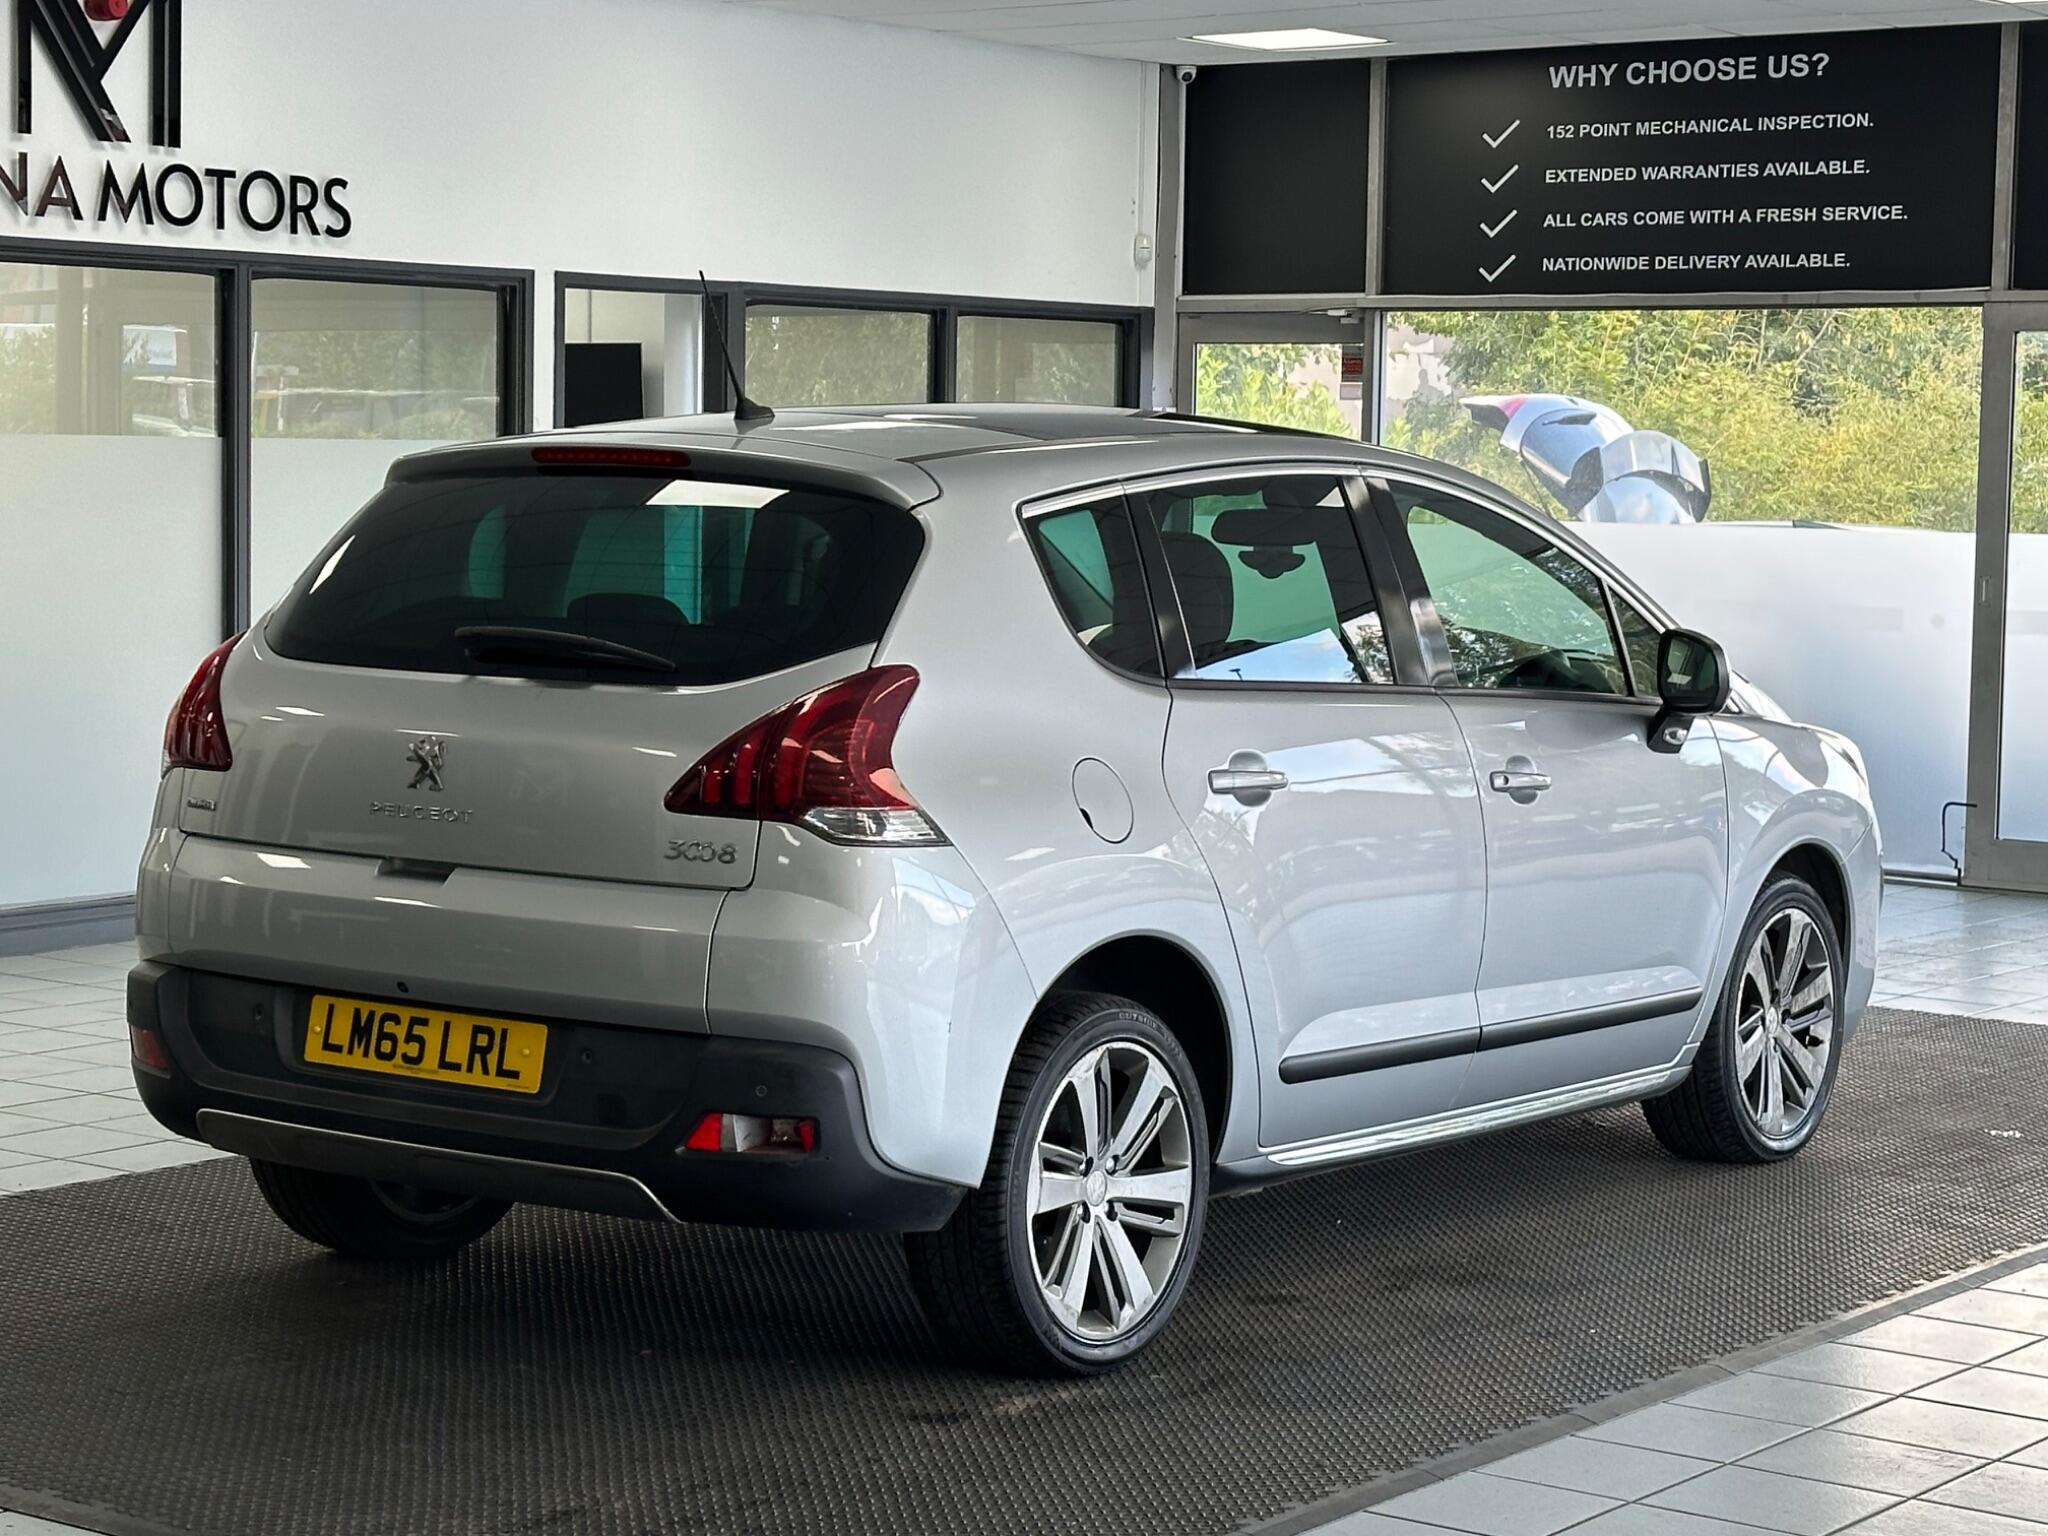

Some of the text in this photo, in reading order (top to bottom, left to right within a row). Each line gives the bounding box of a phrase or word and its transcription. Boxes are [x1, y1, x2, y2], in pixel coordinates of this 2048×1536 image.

[1549, 52, 1830, 88] WHY CHOOSE US?
[1546, 112, 1874, 140] 152 POINT MECHANICAL INSPECTION.
[1545, 159, 1870, 184] EXTENDED WARRANTIES AVAILABLE.
[97, 160, 352, 239] MOTORS
[1543, 205, 1908, 228] ALL CARS COME WITH A FRESH SERVICE.
[1542, 252, 1851, 272] NATIONWIDE DELIVERY AVAILABLE.
[370, 801, 473, 822] PEUGEOT
[663, 840, 737, 864] 3008
[321, 1003, 522, 1080] LM65 LRL
